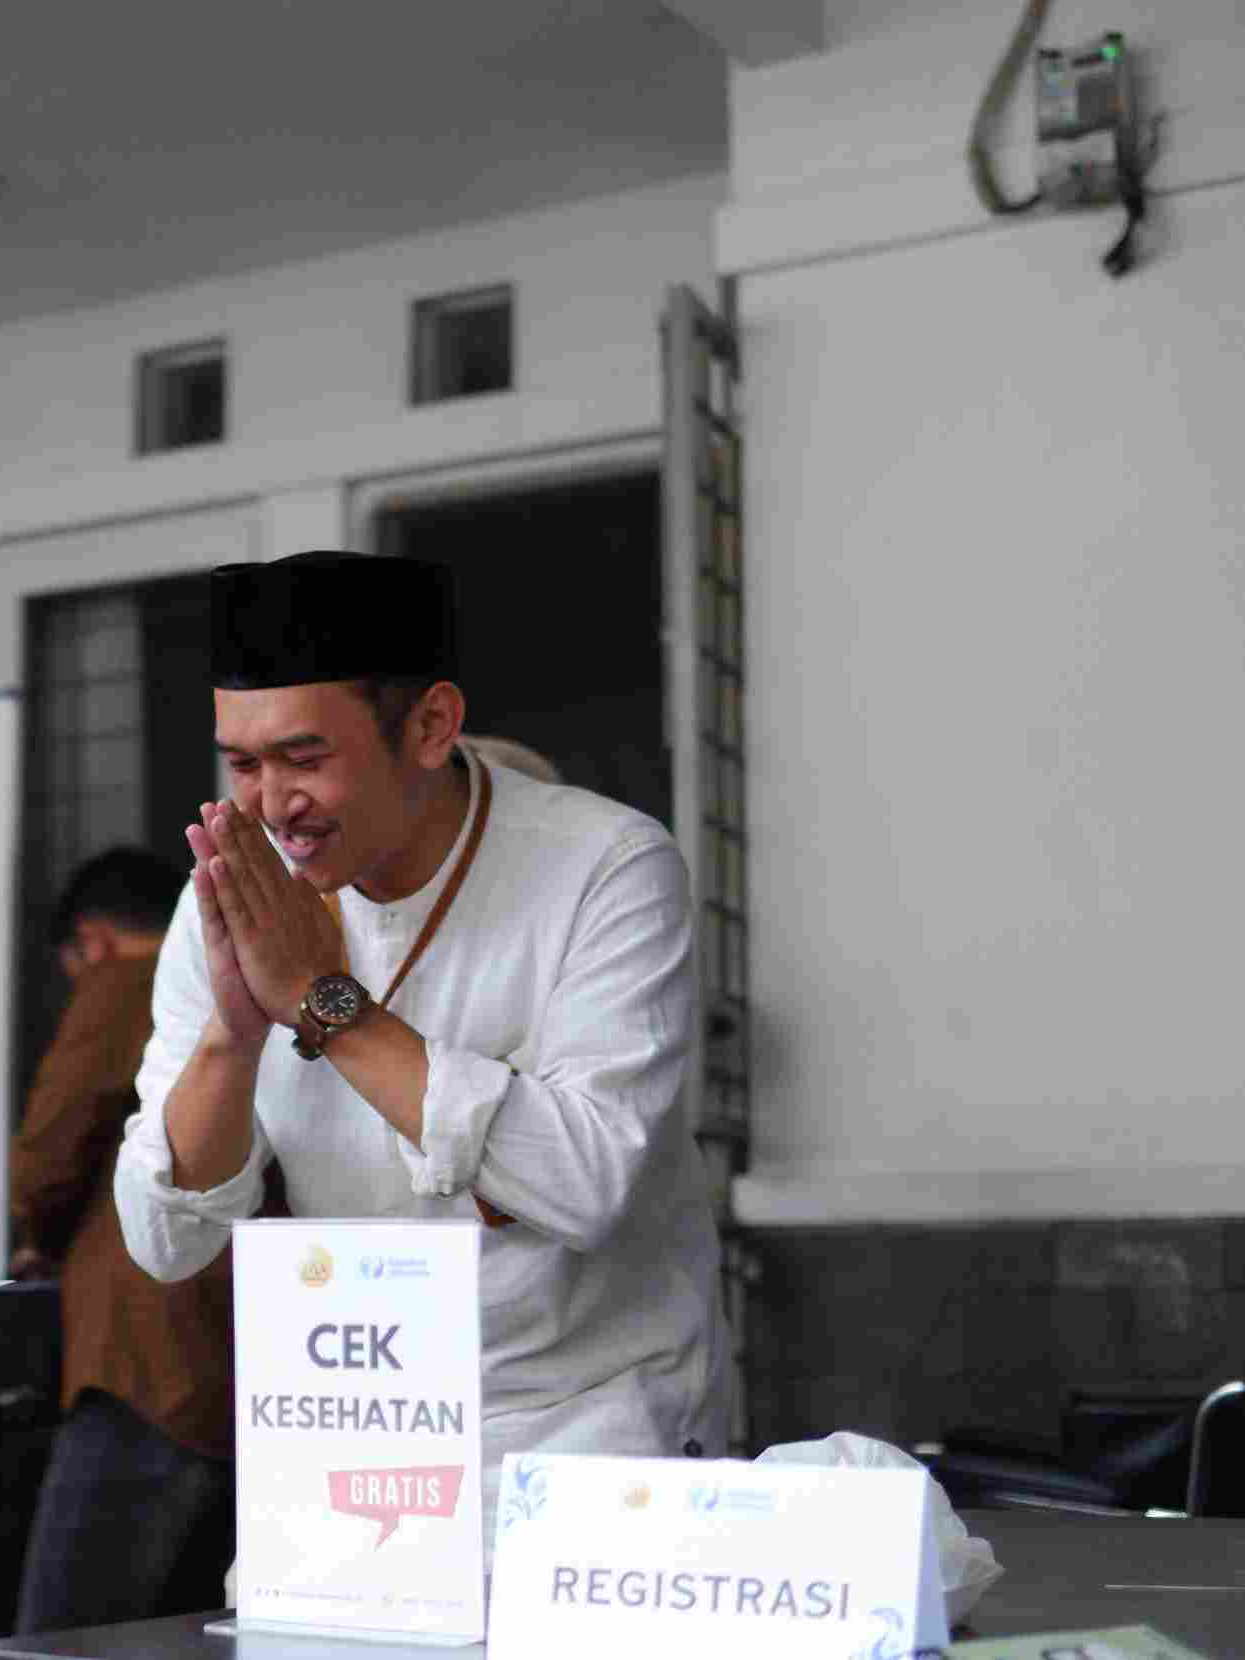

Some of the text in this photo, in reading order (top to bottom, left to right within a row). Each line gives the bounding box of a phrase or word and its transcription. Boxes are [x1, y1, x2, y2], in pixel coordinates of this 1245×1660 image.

[306, 1323, 403, 1370] CEK
[251, 1394, 465, 1434] KESEHATAN
[349, 1474, 442, 1508] GRATIS
[550, 1566, 850, 1620] REGISTRASI
